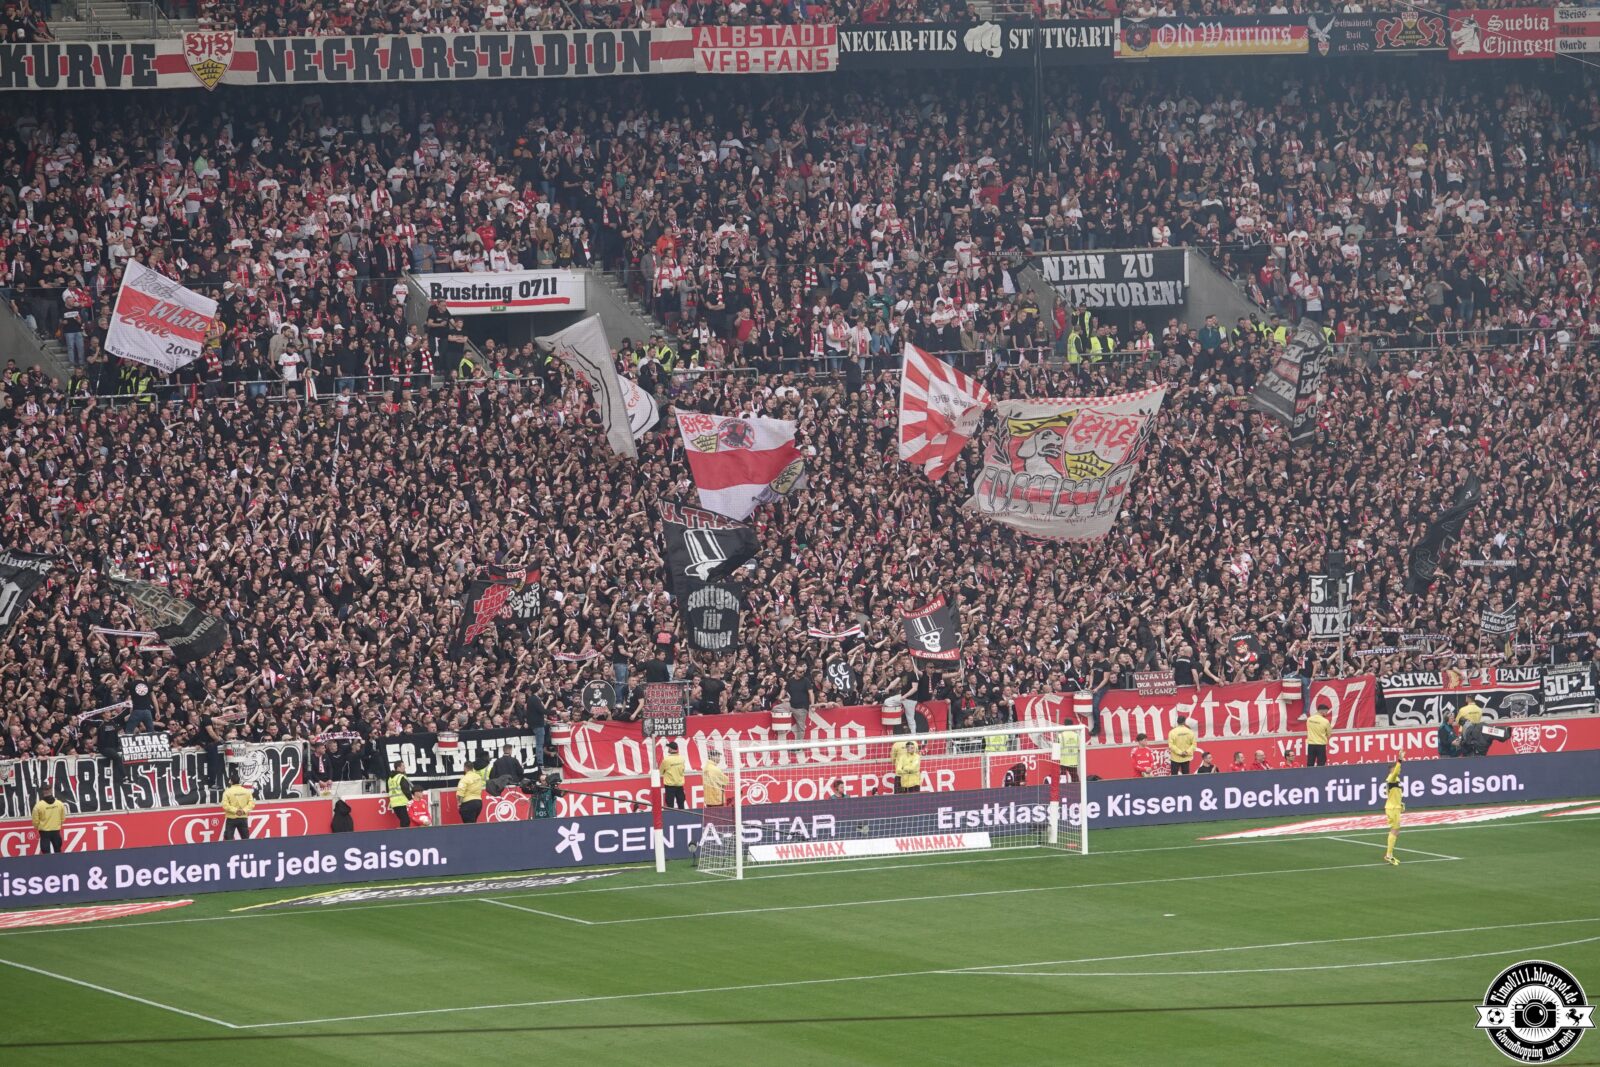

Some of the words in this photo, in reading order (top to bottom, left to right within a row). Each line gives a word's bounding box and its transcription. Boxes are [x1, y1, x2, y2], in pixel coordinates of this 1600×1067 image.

[1157, 23, 1195, 49] Old
[1199, 21, 1291, 49] Warriors
[1487, 15, 1549, 33] Suebia
[697, 26, 829, 48] ALBSTADT
[839, 30, 957, 53] NECKAR-FILS
[1483, 37, 1553, 56] Ehingen
[0, 43, 158, 88] KURVE
[256, 31, 650, 84] NECKARSTADION
[701, 50, 831, 72] VFB-FANS
[1042, 254, 1106, 281] NEIN
[1121, 253, 1154, 279] ZU
[430, 282, 513, 303] Brustring
[518, 277, 557, 298] 0711
[119, 306, 172, 338] Zone
[148, 301, 208, 332] White
[702, 609, 723, 631] für
[694, 626, 732, 651] immer
[1381, 671, 1443, 688] SCHWA
[1495, 666, 1541, 682] PANIE
[1543, 671, 1596, 696] 50+1
[1022, 684, 1303, 750] Cnnstatt
[1308, 680, 1368, 729] 97
[121, 734, 169, 748] ULTRAS
[122, 744, 170, 755] BEDEUTET
[1329, 729, 1439, 755] STIFTUNG
[123, 751, 173, 762] WIDERSTAND
[777, 769, 956, 803] JOKERSAR
[937, 798, 1101, 830] Erstklassige
[1107, 793, 1193, 818] Kissen
[1199, 787, 1218, 811] &
[1224, 785, 1320, 811] Decken
[1325, 778, 1366, 804] für
[1431, 771, 1524, 796] Saison.
[774, 841, 847, 860] WINAMAX
[893, 833, 966, 853] WINAMAX
[0, 873, 80, 898] issen
[87, 867, 108, 891] &
[114, 859, 222, 889] Decken
[226, 853, 272, 881] für
[273, 849, 338, 882] jede
[343, 844, 448, 872] Saison.
